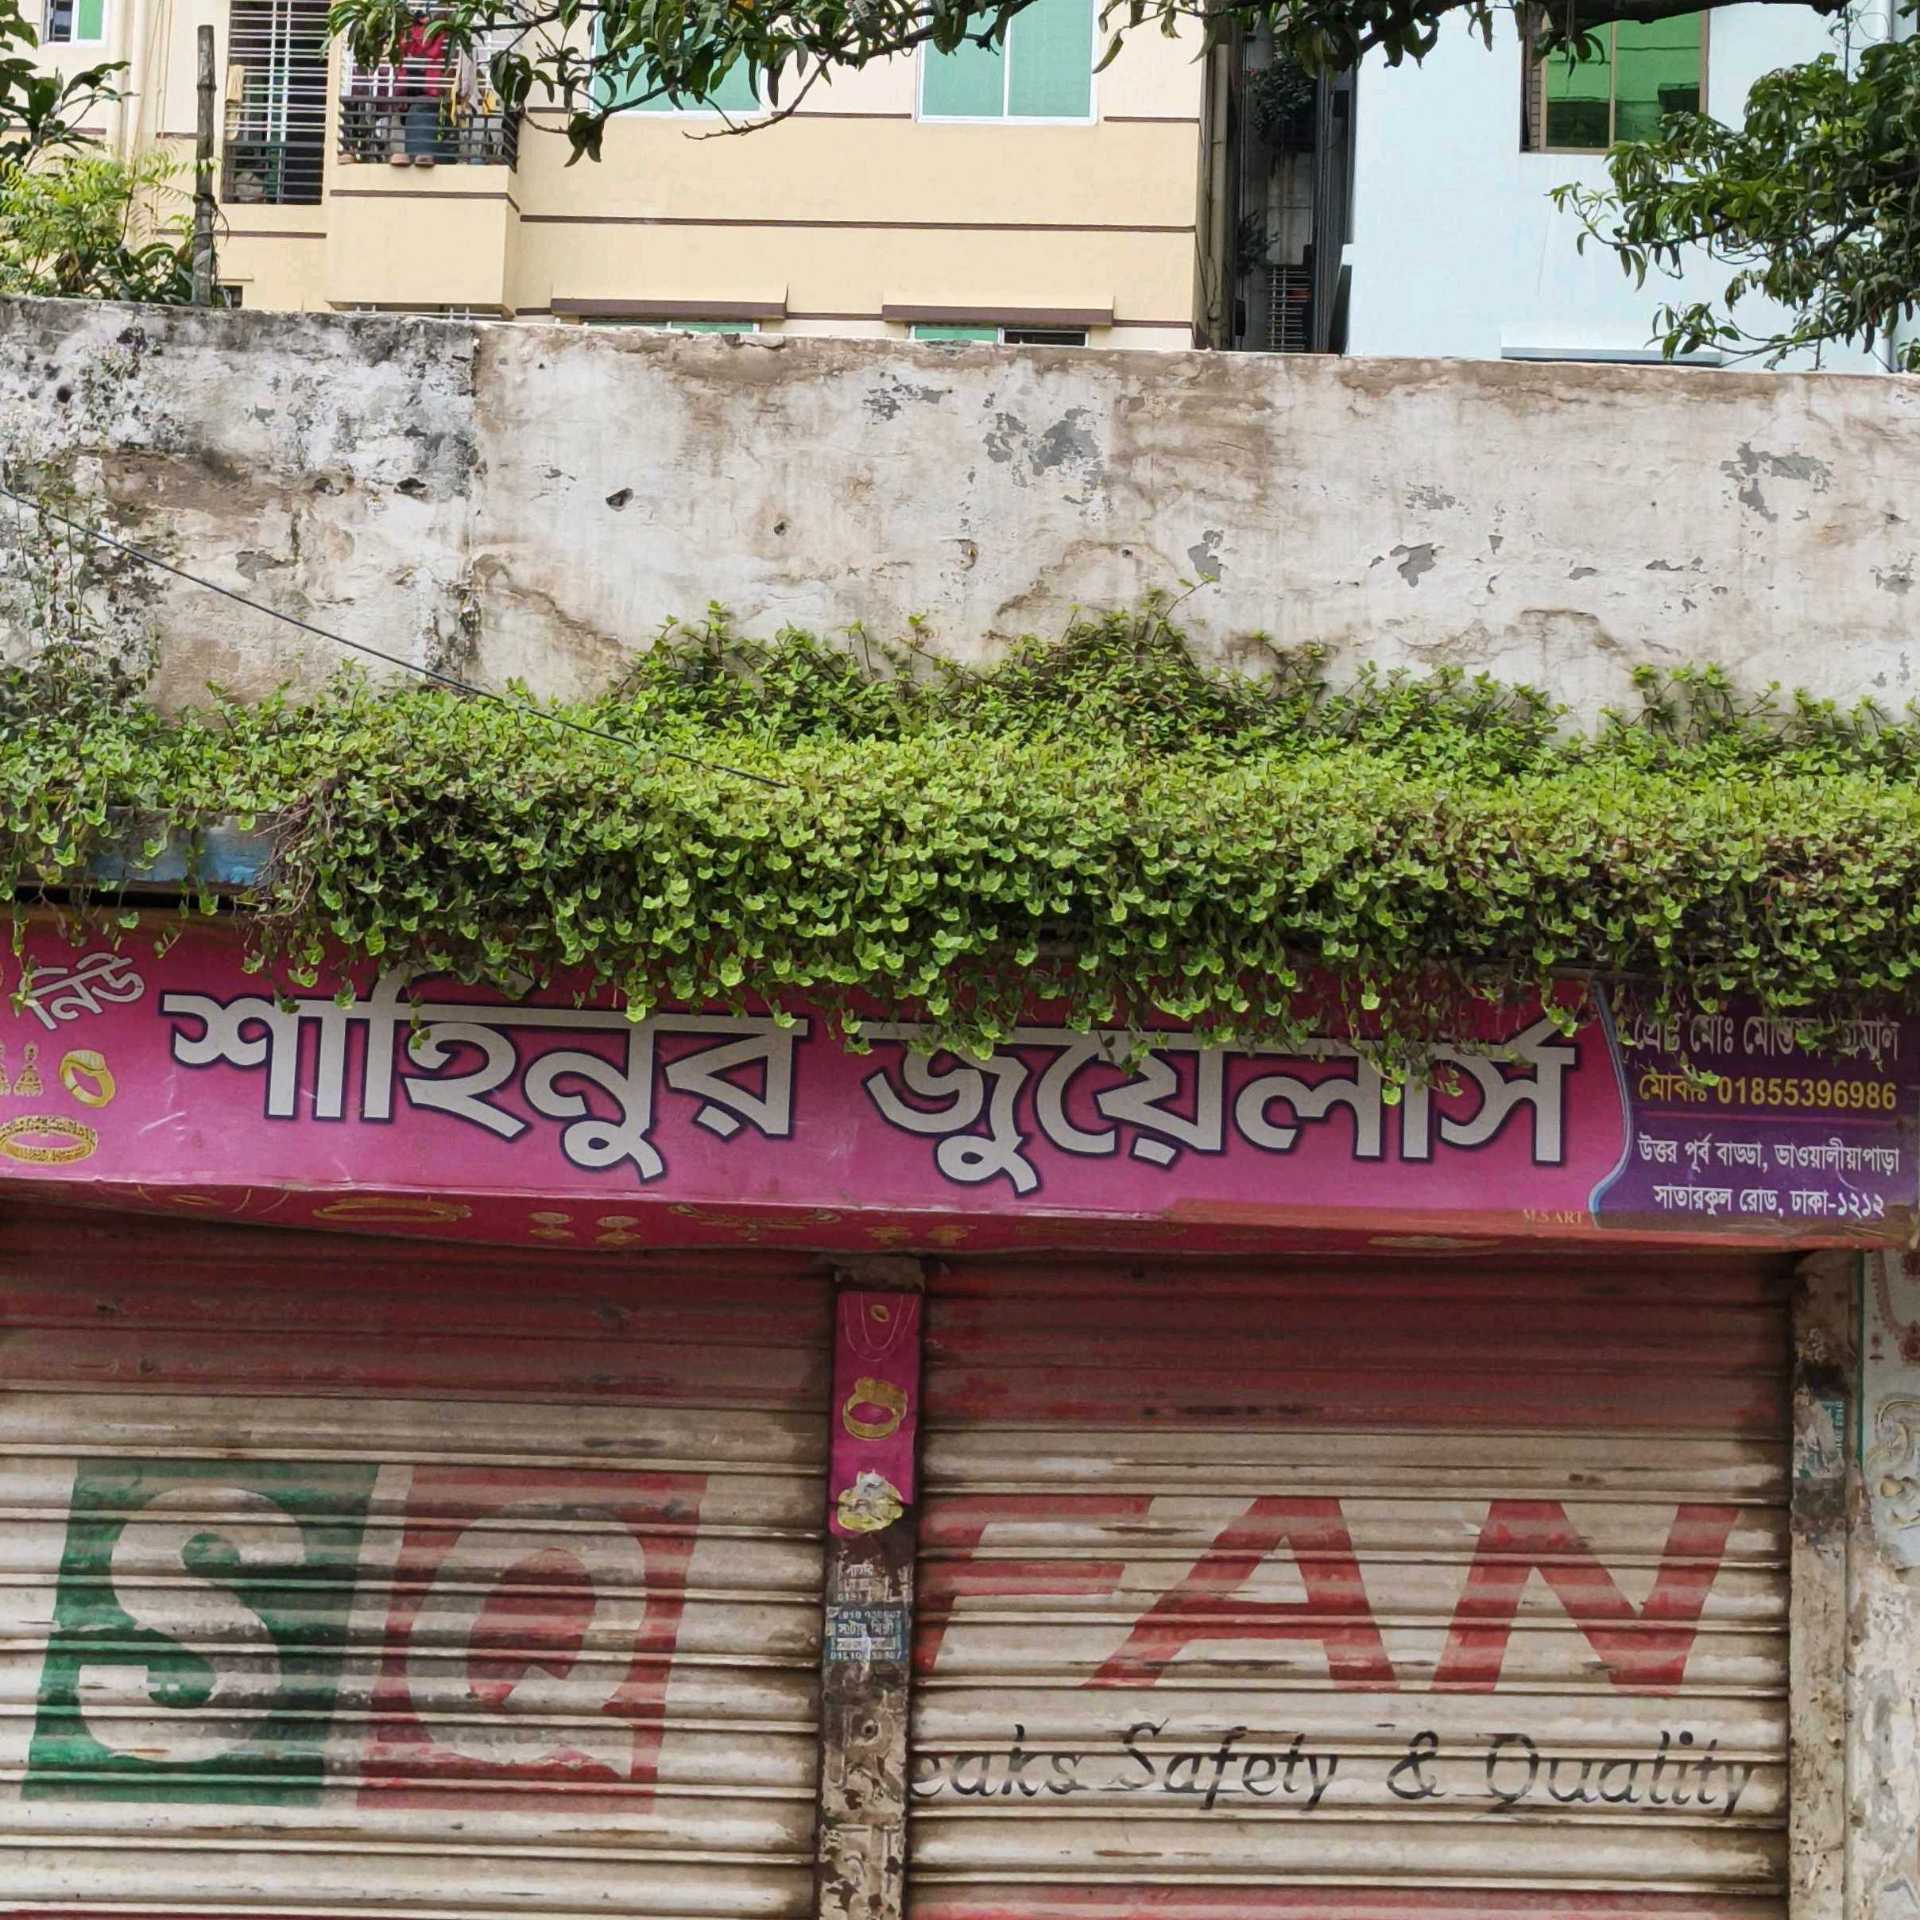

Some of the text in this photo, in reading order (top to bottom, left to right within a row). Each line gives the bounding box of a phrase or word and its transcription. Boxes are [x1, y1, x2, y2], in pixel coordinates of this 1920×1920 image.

[18, 952, 145, 1030] নিউ
[160, 962, 1576, 1194] শাহিনুর জুয়েলার্স
[1717, 1075, 1898, 1110] 01855396986
[1637, 1132, 1678, 1164] উত্তর
[1684, 1132, 1712, 1174] পূর্ব
[1714, 1140, 1768, 1174] বাড্ডা,
[1652, 1183, 1885, 1218] সাতারকুল রোড, ঢাকা-১২১২
[916, 1495, 1741, 1697] FAN
[1113, 1717, 1340, 1810] Safety
[1386, 1730, 1448, 1800] &
[1484, 1730, 1756, 1818] Quality
